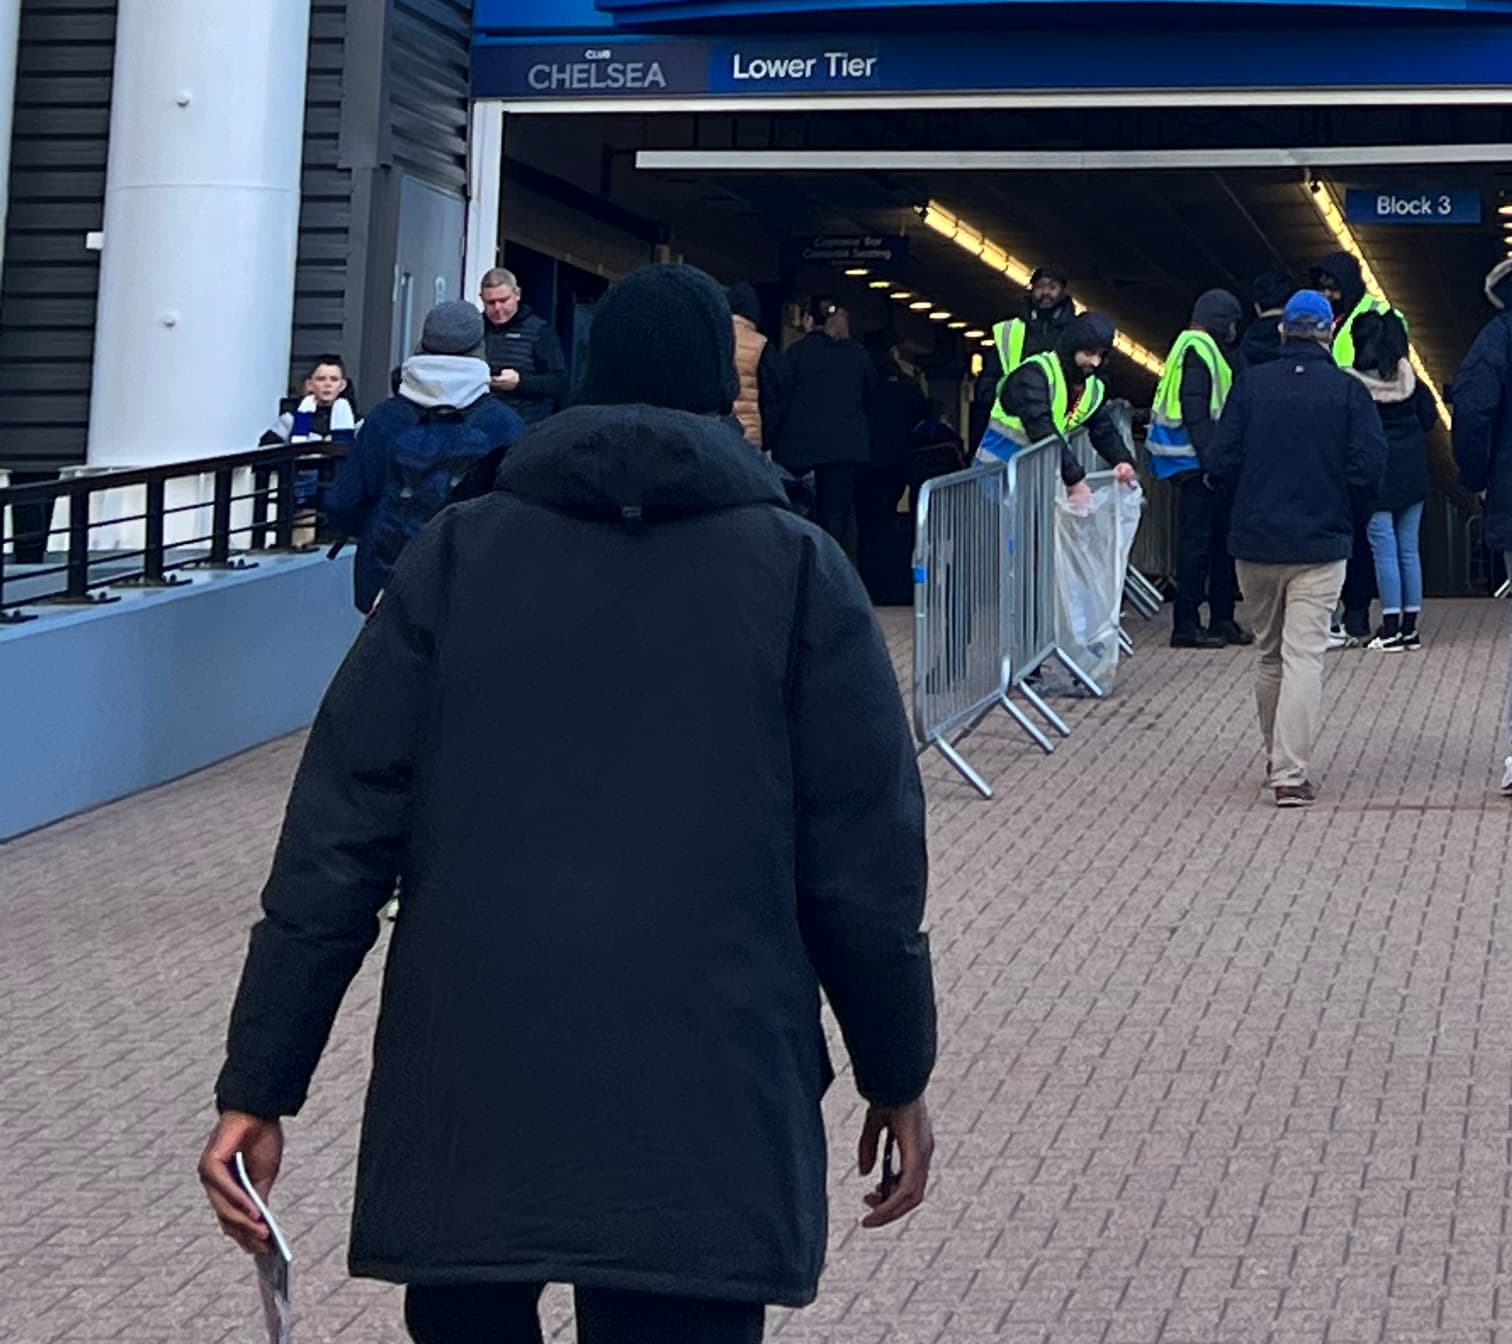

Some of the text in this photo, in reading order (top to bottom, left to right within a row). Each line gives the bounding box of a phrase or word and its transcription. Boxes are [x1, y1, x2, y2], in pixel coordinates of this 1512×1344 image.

[528, 62, 667, 90] CHELSEA
[732, 52, 877, 80] Lower Tier
[1376, 195, 1453, 215] Block 3
